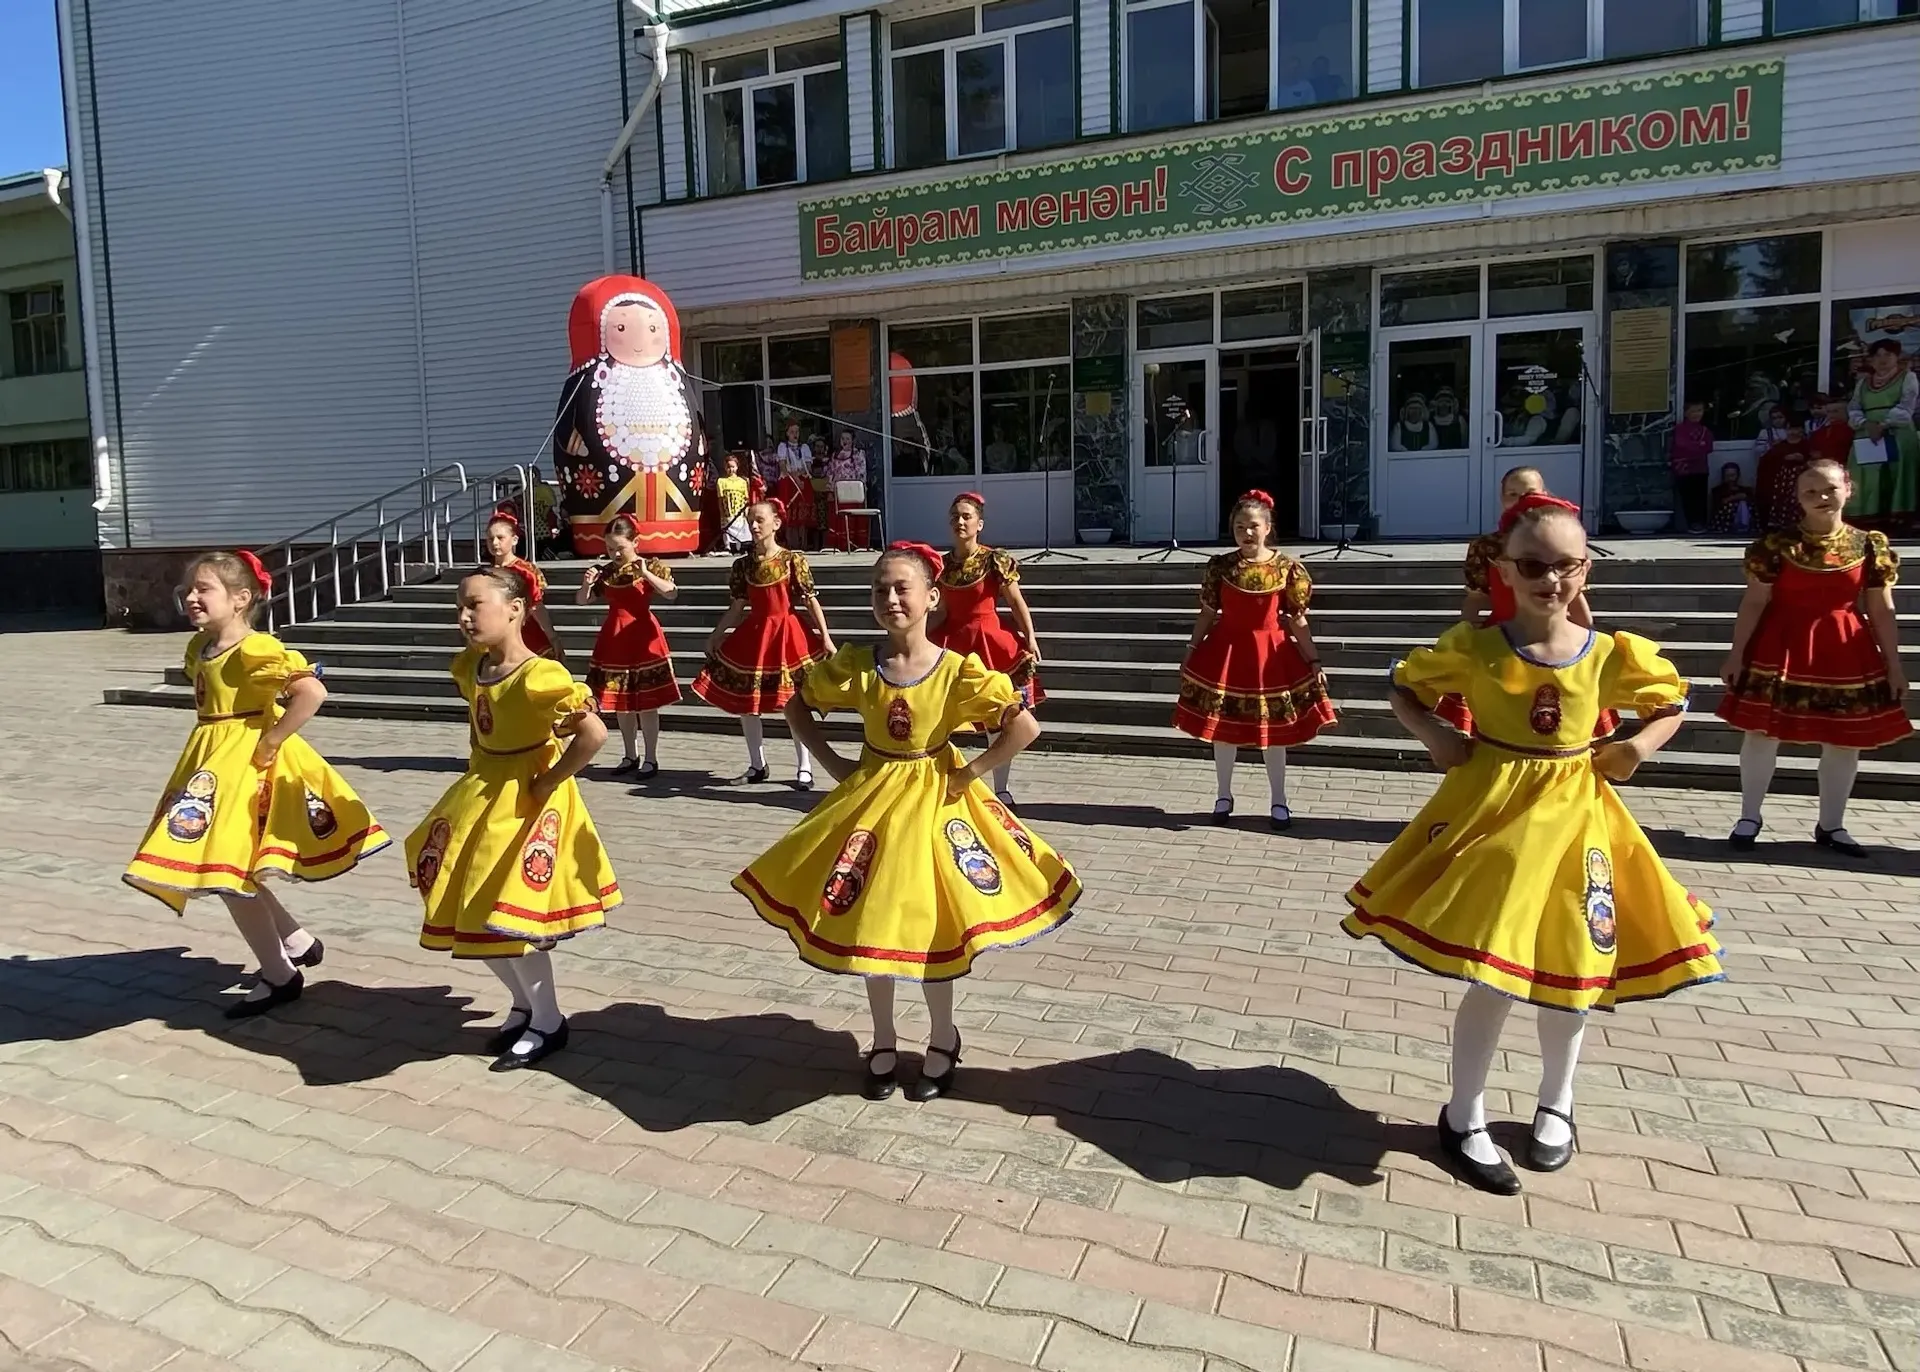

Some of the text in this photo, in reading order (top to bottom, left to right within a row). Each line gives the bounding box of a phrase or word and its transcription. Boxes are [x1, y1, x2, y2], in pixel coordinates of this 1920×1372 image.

[1273, 87, 1751, 198] С праздником!
[815, 166, 1168, 258] Байрам менән!
